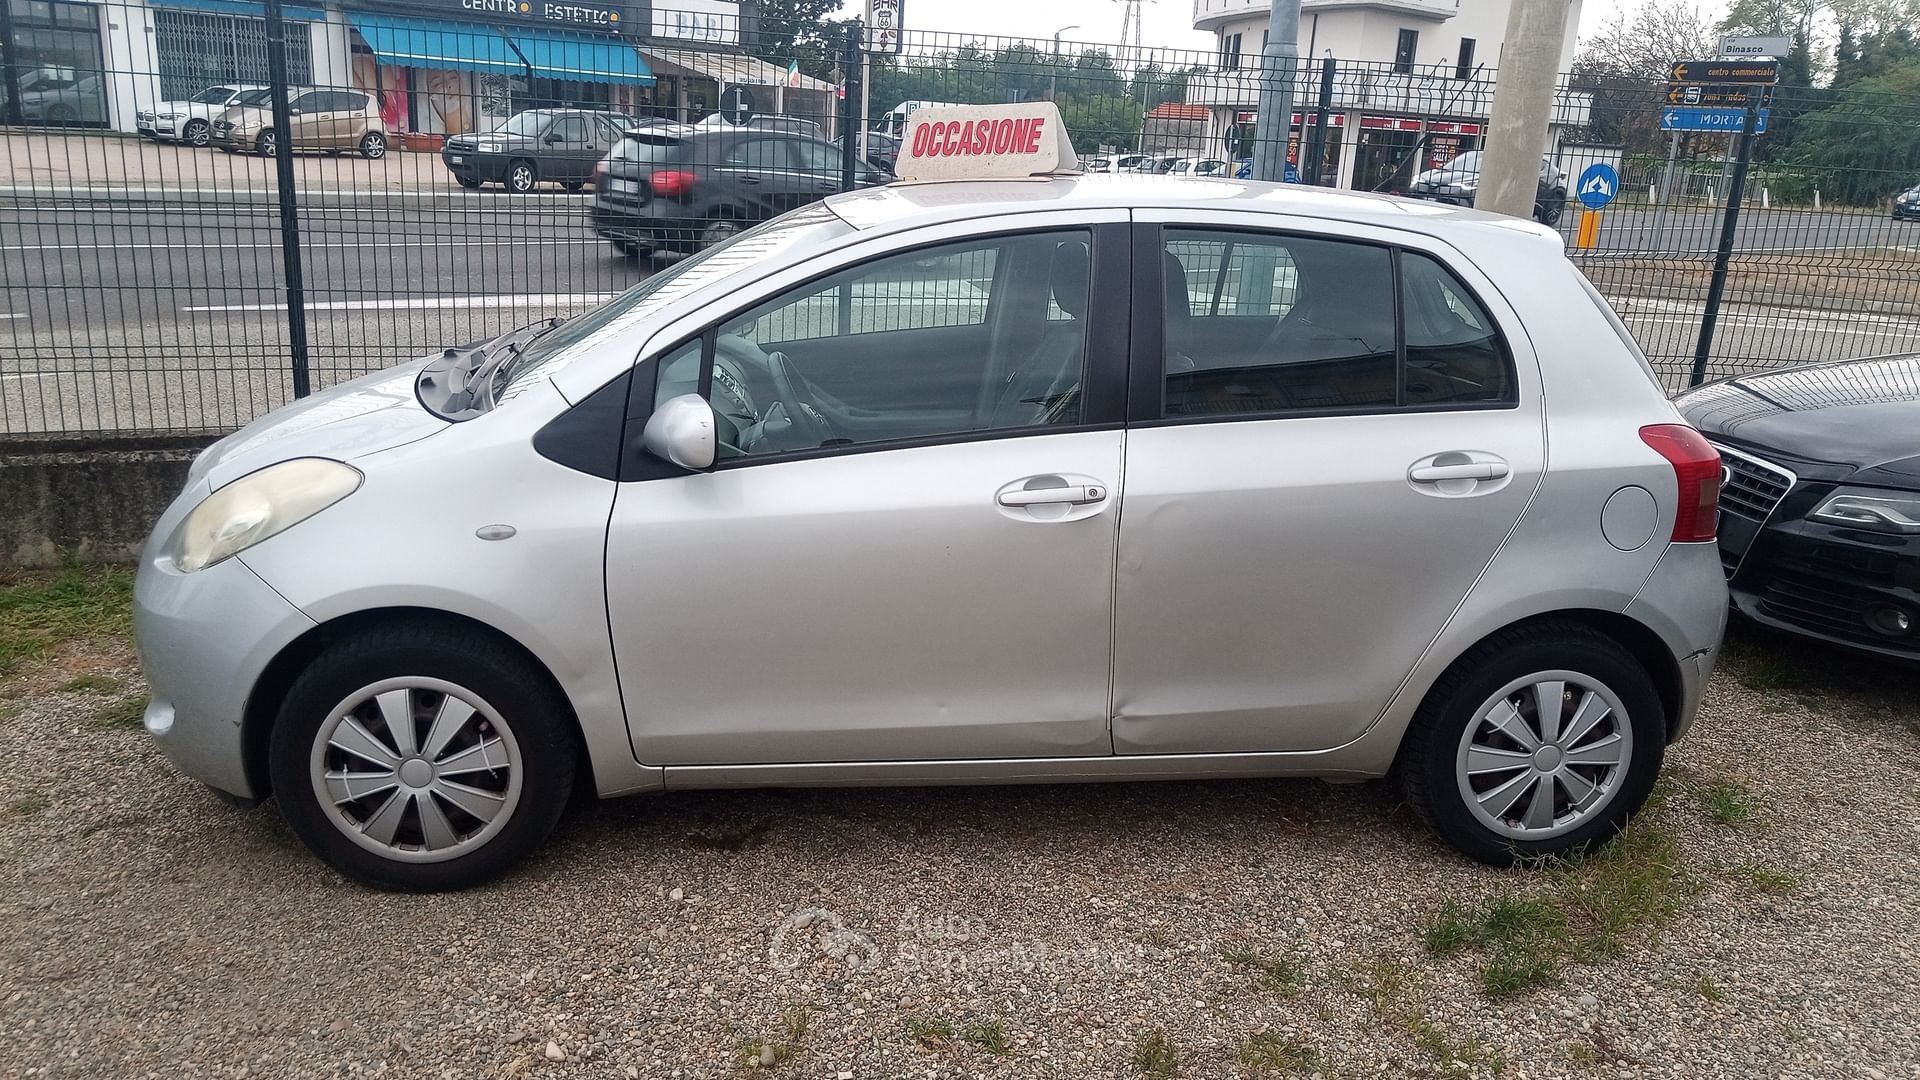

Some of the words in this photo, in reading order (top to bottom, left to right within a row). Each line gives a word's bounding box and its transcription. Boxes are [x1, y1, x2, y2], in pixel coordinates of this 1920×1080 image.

[544, 4, 620, 24] ESTETICO
[880, 17, 889, 26] 66
[1726, 45, 1763, 53] Binasco
[1708, 68, 1729, 76] centro
[1731, 67, 1774, 76] commerciale
[912, 117, 1045, 158] OCCASIONE
